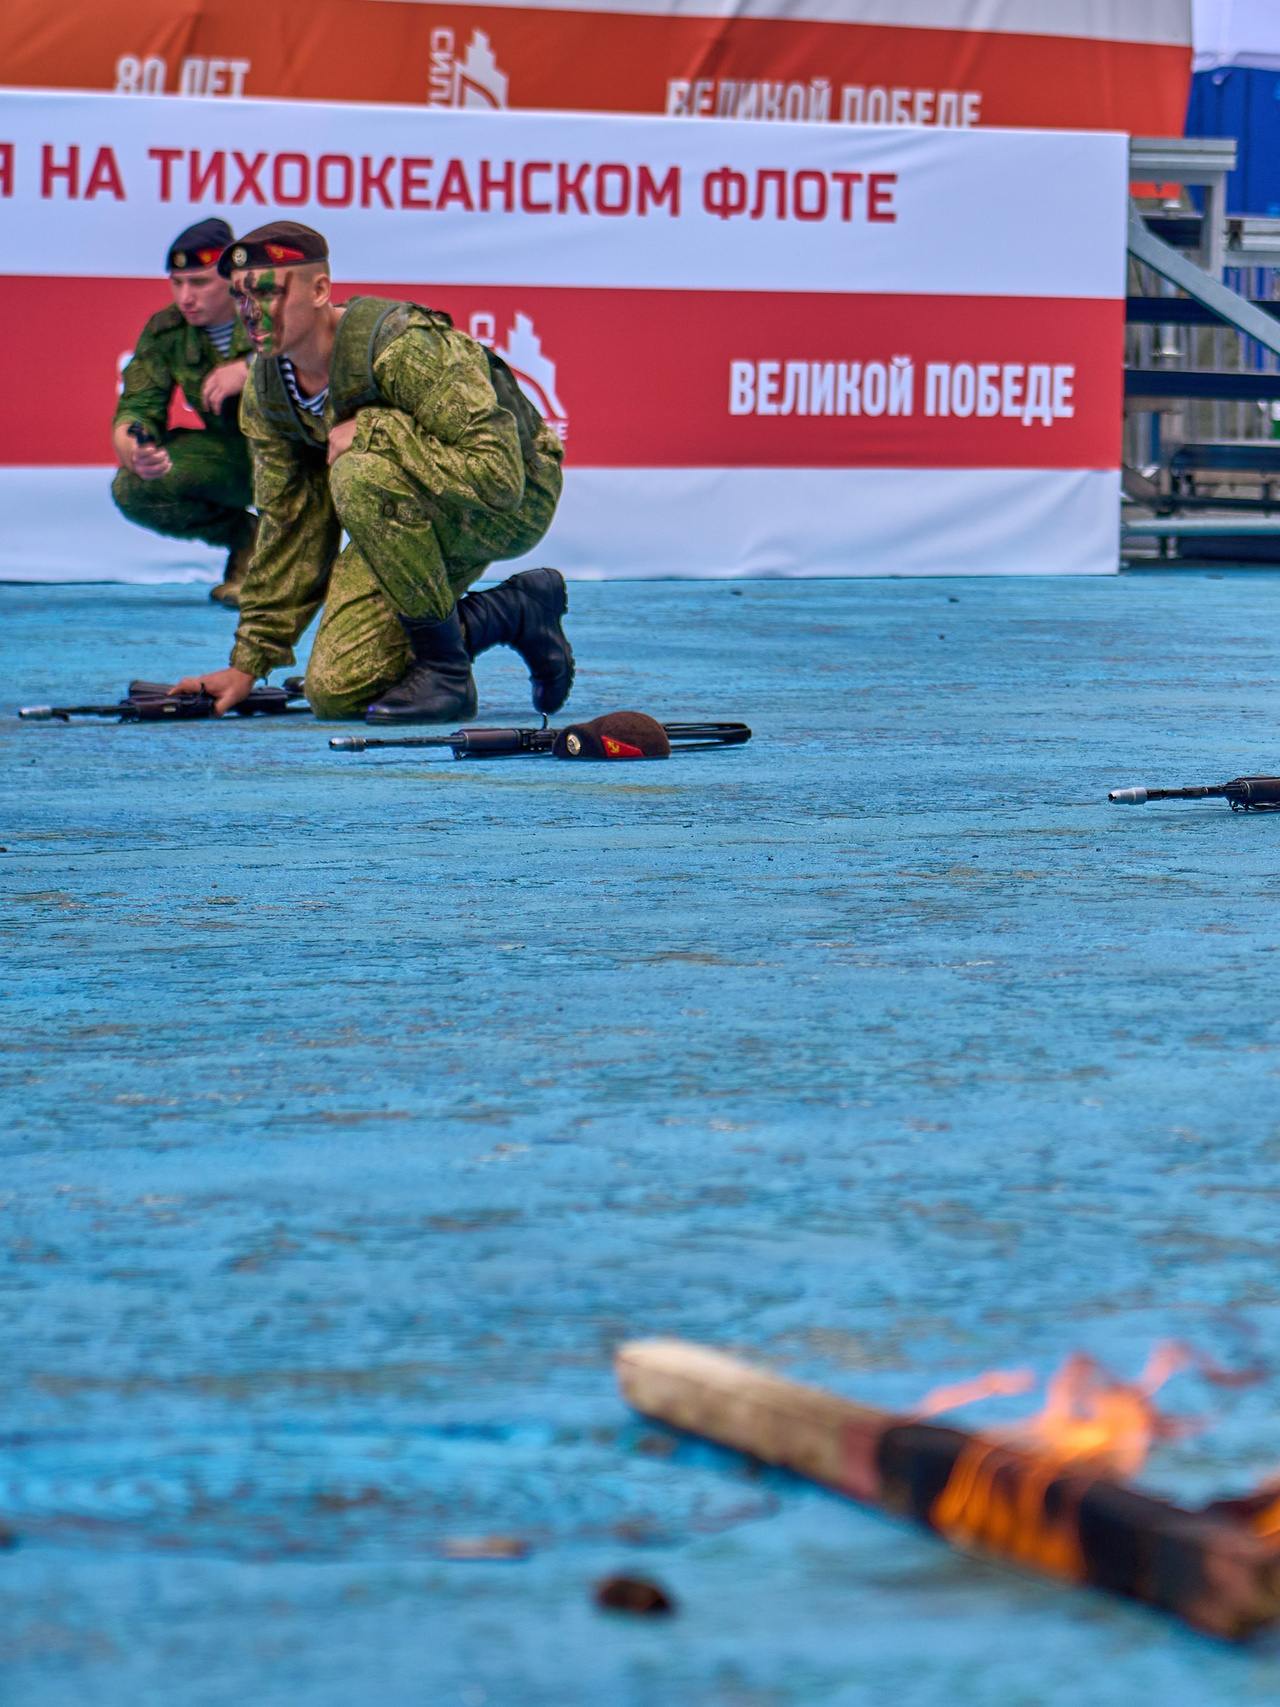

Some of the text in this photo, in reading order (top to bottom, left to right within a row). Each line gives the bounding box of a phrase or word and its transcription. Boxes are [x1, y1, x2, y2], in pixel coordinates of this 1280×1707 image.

[115, 55, 167, 97] 80
[180, 57, 252, 99] ЛЕТ
[667, 77, 831, 122] ВЕЛИКОЙ
[41, 143, 127, 201] НА
[149, 147, 681, 217] ТИХООКЕАНСКОМ
[702, 166, 898, 223] ФЛОТЕ
[729, 356, 1076, 427] ВЕЛИКОЙ ПОБЕДЕ
